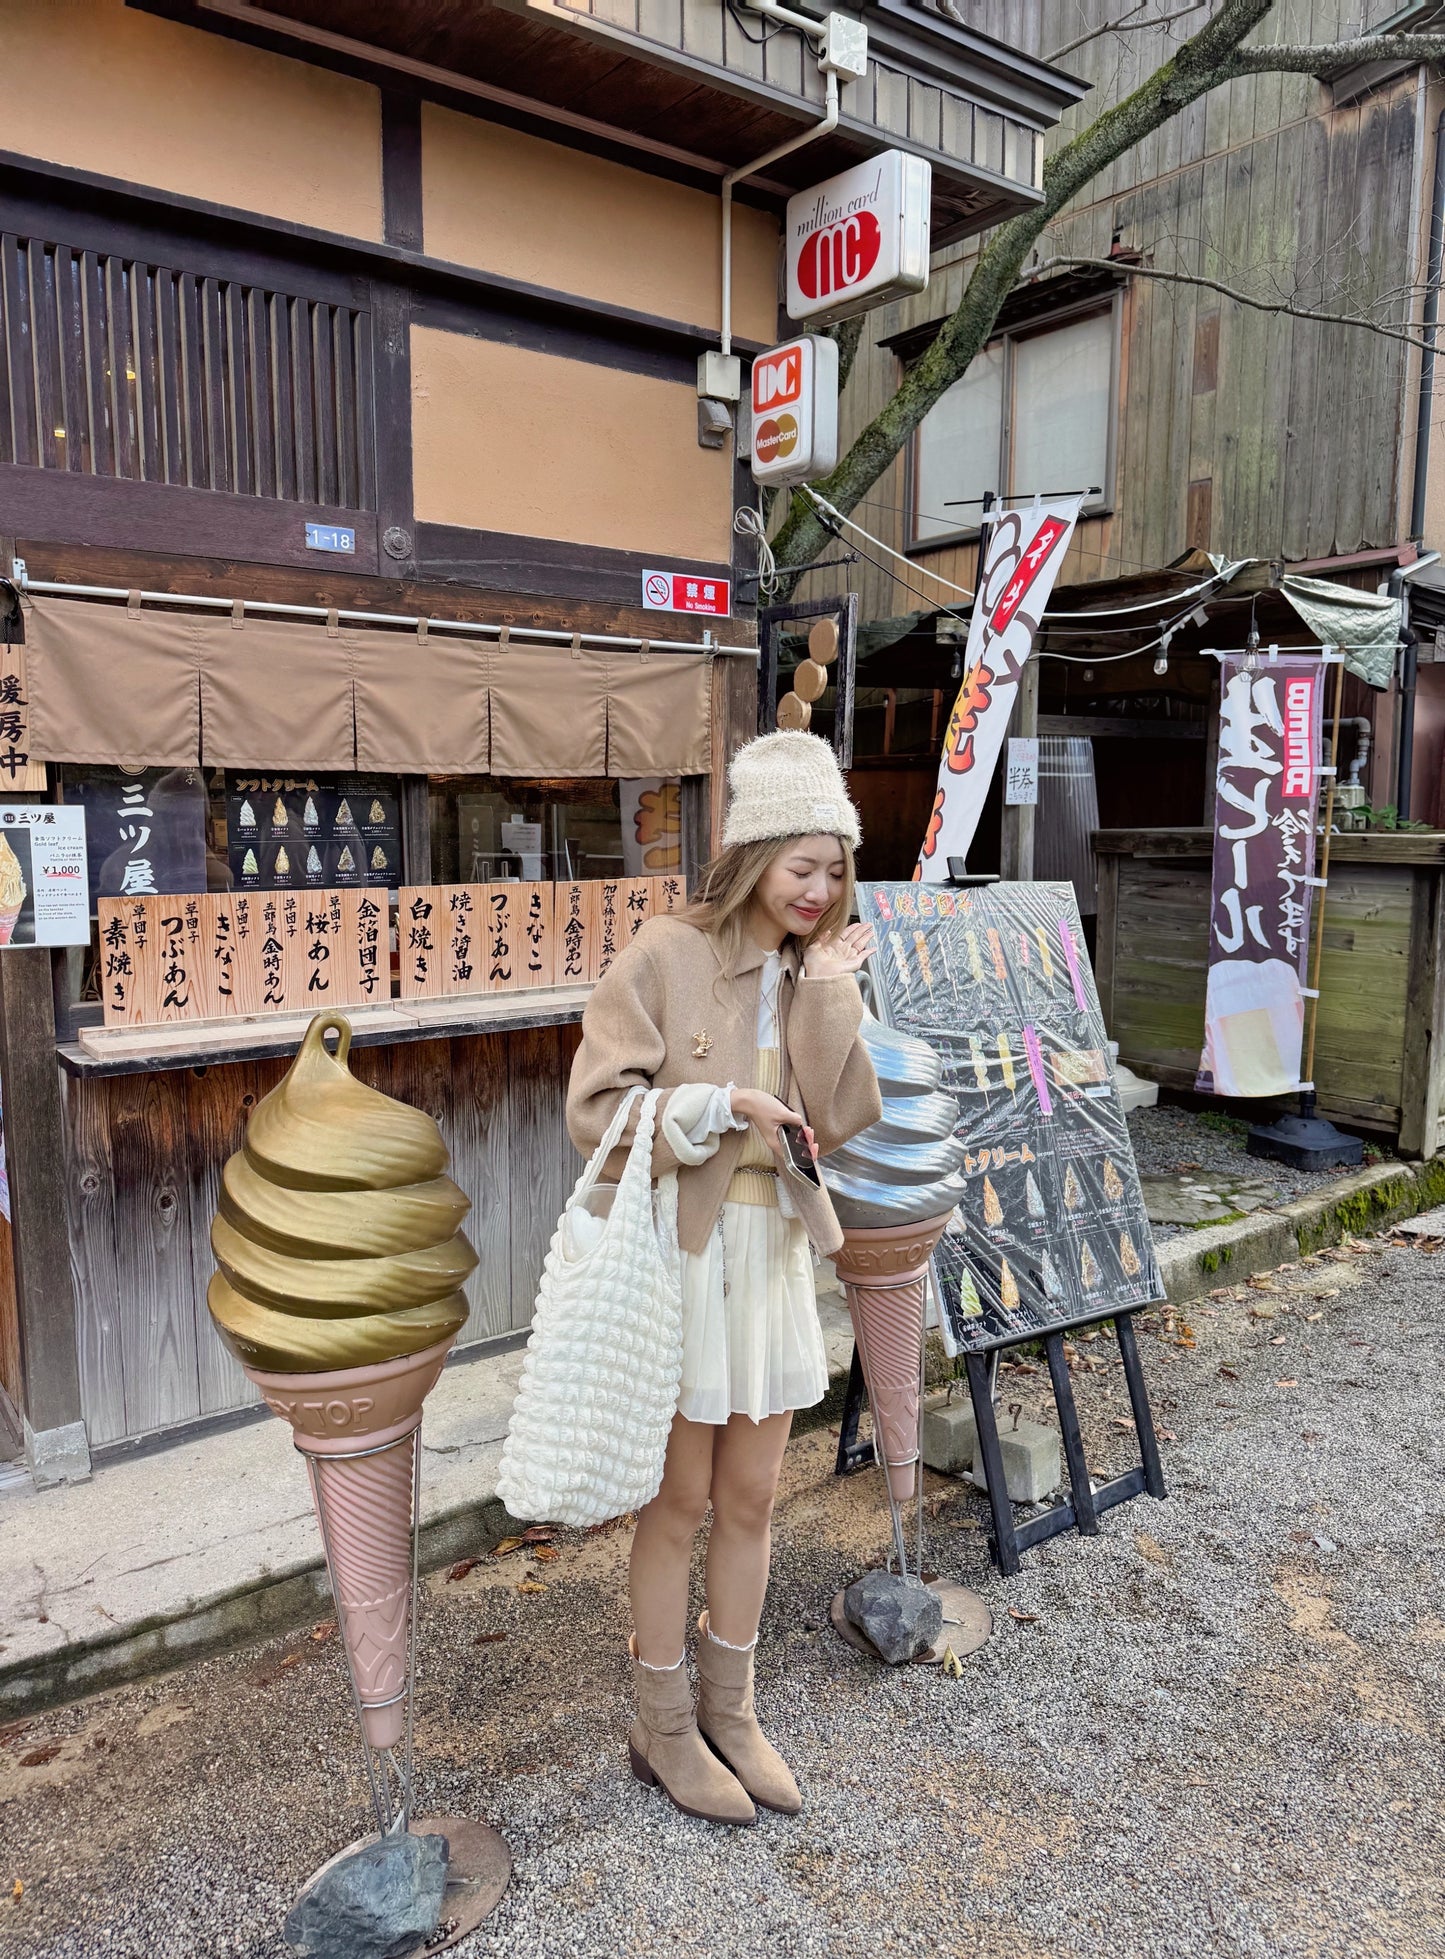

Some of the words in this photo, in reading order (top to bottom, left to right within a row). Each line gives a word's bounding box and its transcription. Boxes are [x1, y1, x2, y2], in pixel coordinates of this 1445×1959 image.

[797, 197, 843, 237] million
[847, 168, 882, 213] card
[759, 355, 795, 405] DC
[756, 426, 798, 450] MasterCard
[312, 529, 350, 549] 1-18
[686, 582, 716, 600] 禁煙
[686, 601, 694, 609] No
[695, 602, 716, 612] Smoking
[0, 674, 29, 779] 暖房中
[19, 812, 56, 825] 三ツ屋
[116, 783, 159, 896] 三ツ屋
[132, 904, 148, 949] 草団子
[185, 901, 200, 943] 草団子
[236, 899, 250, 939] 草団子
[284, 897, 297, 937] 草団子
[329, 895, 341, 934] 草団子
[408, 897, 433, 983] 白焼き
[450, 890, 473, 981] 焼き醤油
[488, 894, 512, 981] つぶあん
[526, 892, 545, 971] きなこ
[102, 916, 133, 1011] 素焼き
[161, 916, 188, 1008] つぶあん
[214, 912, 235, 995] きなこ
[305, 911, 329, 991] 桜あん
[356, 897, 381, 994] 金箔団子
[303, 1397, 376, 1427] TOP
